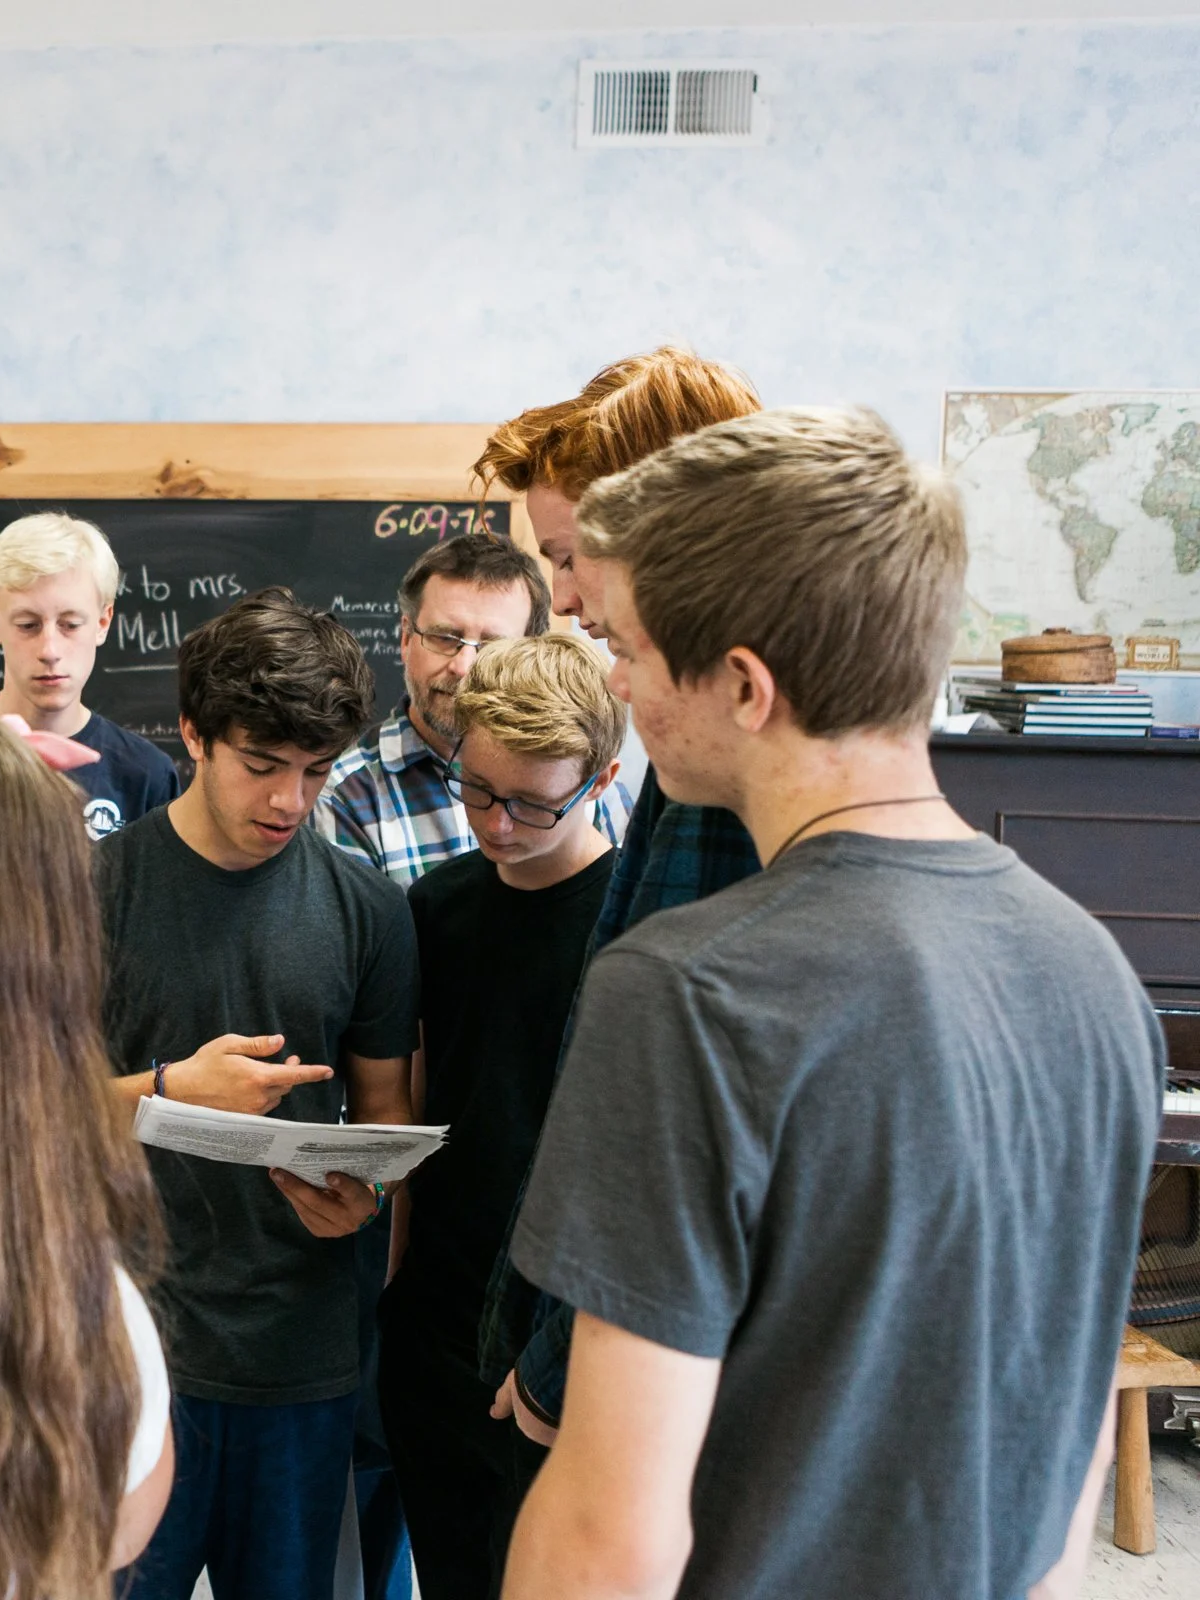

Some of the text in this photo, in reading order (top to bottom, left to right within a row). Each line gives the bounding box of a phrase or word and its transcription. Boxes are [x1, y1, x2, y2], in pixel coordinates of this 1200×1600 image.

[142, 564, 170, 601] to
[190, 573, 247, 599] mrs.
[331, 595, 399, 613] Memories
